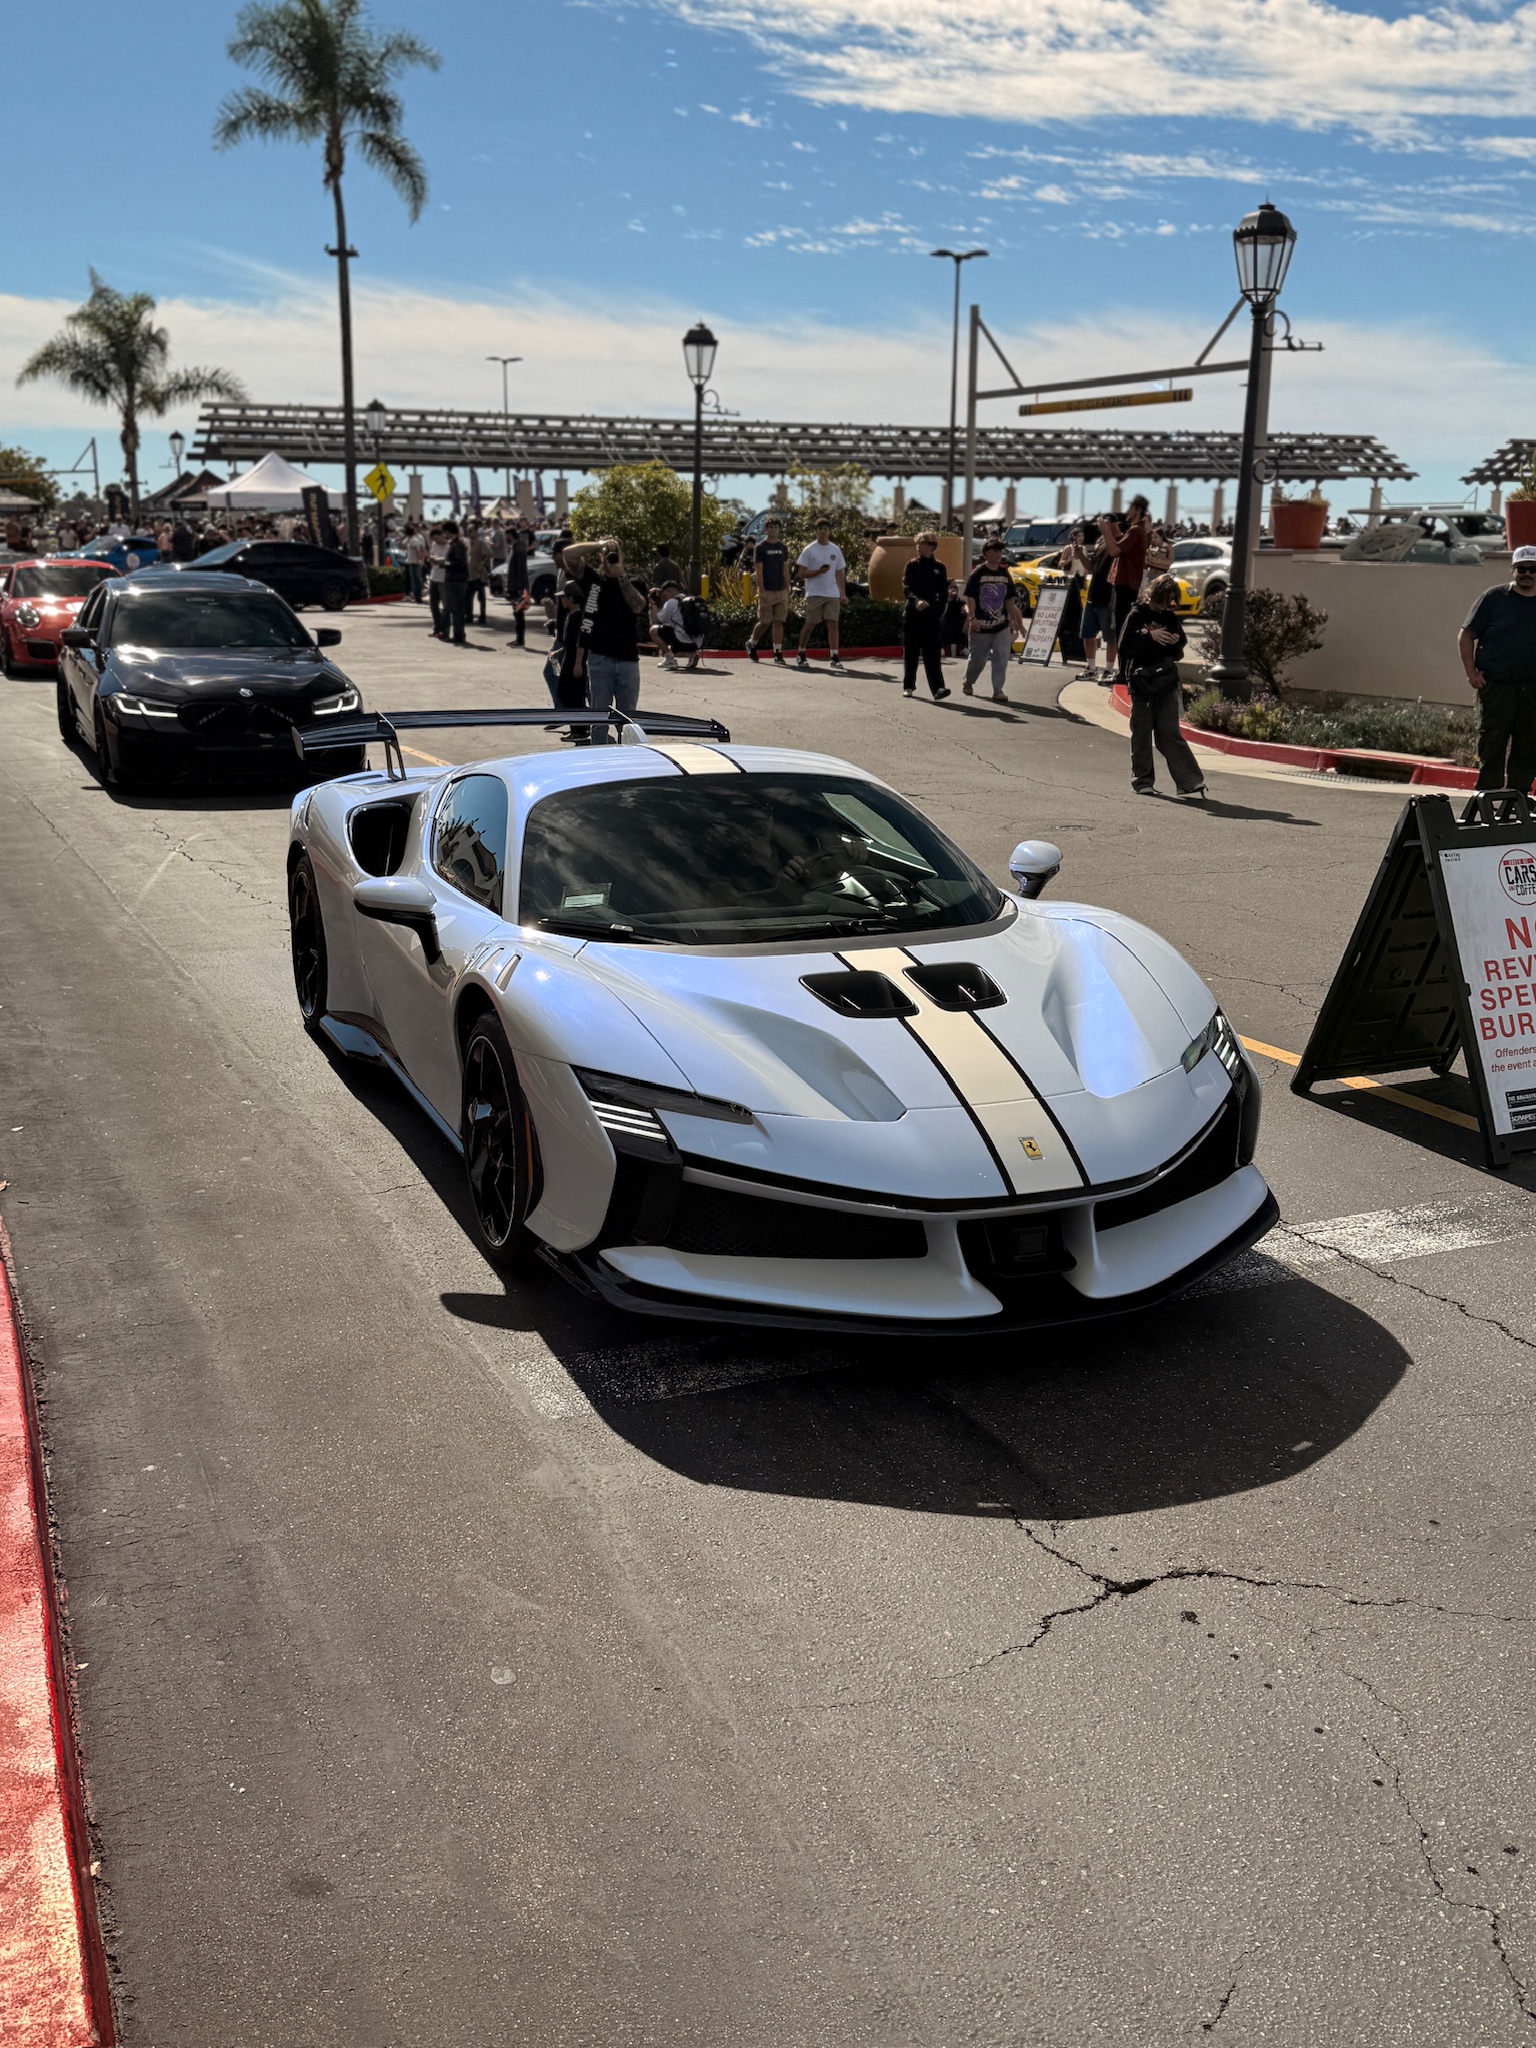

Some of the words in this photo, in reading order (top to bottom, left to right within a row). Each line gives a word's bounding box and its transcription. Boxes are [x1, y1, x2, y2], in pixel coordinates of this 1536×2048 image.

[1086, 396, 1132, 410] CLEARANCE
[1032, 619, 1058, 627] SPLITTING
[1045, 612, 1058, 620] LANE
[580, 618, 594, 634] OC
[1029, 634, 1053, 643] PROPERTY
[1505, 865, 1536, 885] CARS
[1505, 917, 1536, 950] N
[1484, 955, 1536, 982] REV
[1491, 1063, 1506, 1073] the
[1507, 1060, 1531, 1071] event
